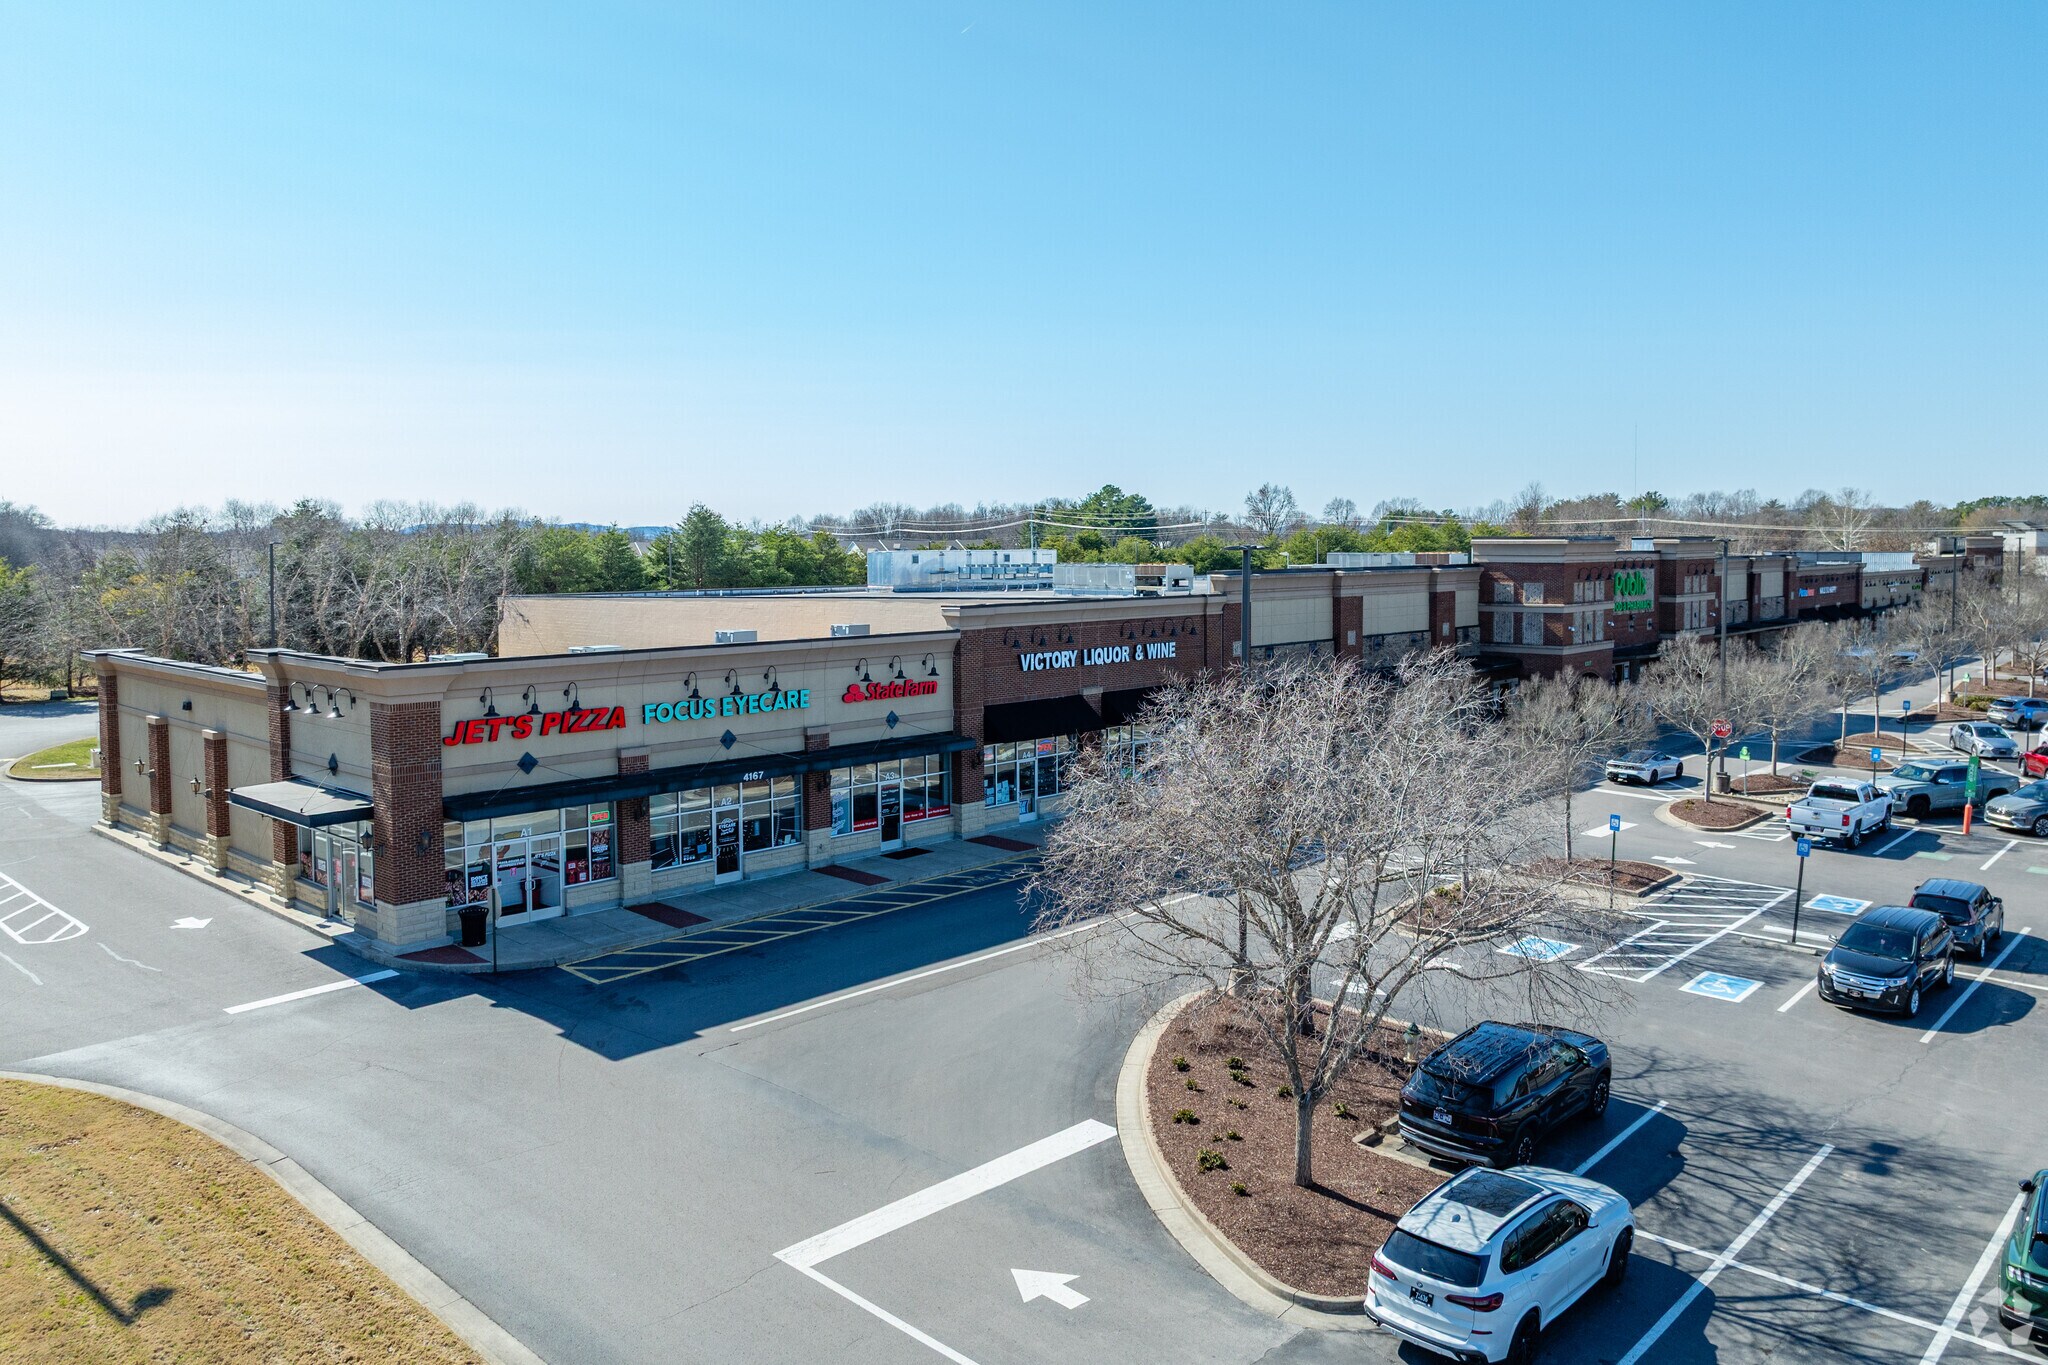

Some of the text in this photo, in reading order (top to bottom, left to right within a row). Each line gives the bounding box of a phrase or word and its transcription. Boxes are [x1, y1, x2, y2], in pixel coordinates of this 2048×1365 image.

[1613, 571, 1646, 597] Publix
[1019, 641, 1176, 672] VICTORY LIQUOR & WINE
[643, 689, 811, 725] FOCUS EYECARE
[443, 706, 627, 747] JET'S PIZZA
[743, 771, 764, 781] 4167
[885, 771, 895, 780] A3
[720, 797, 732, 806] A2
[591, 812, 609, 821] OPEN
[520, 827, 532, 838] A1
